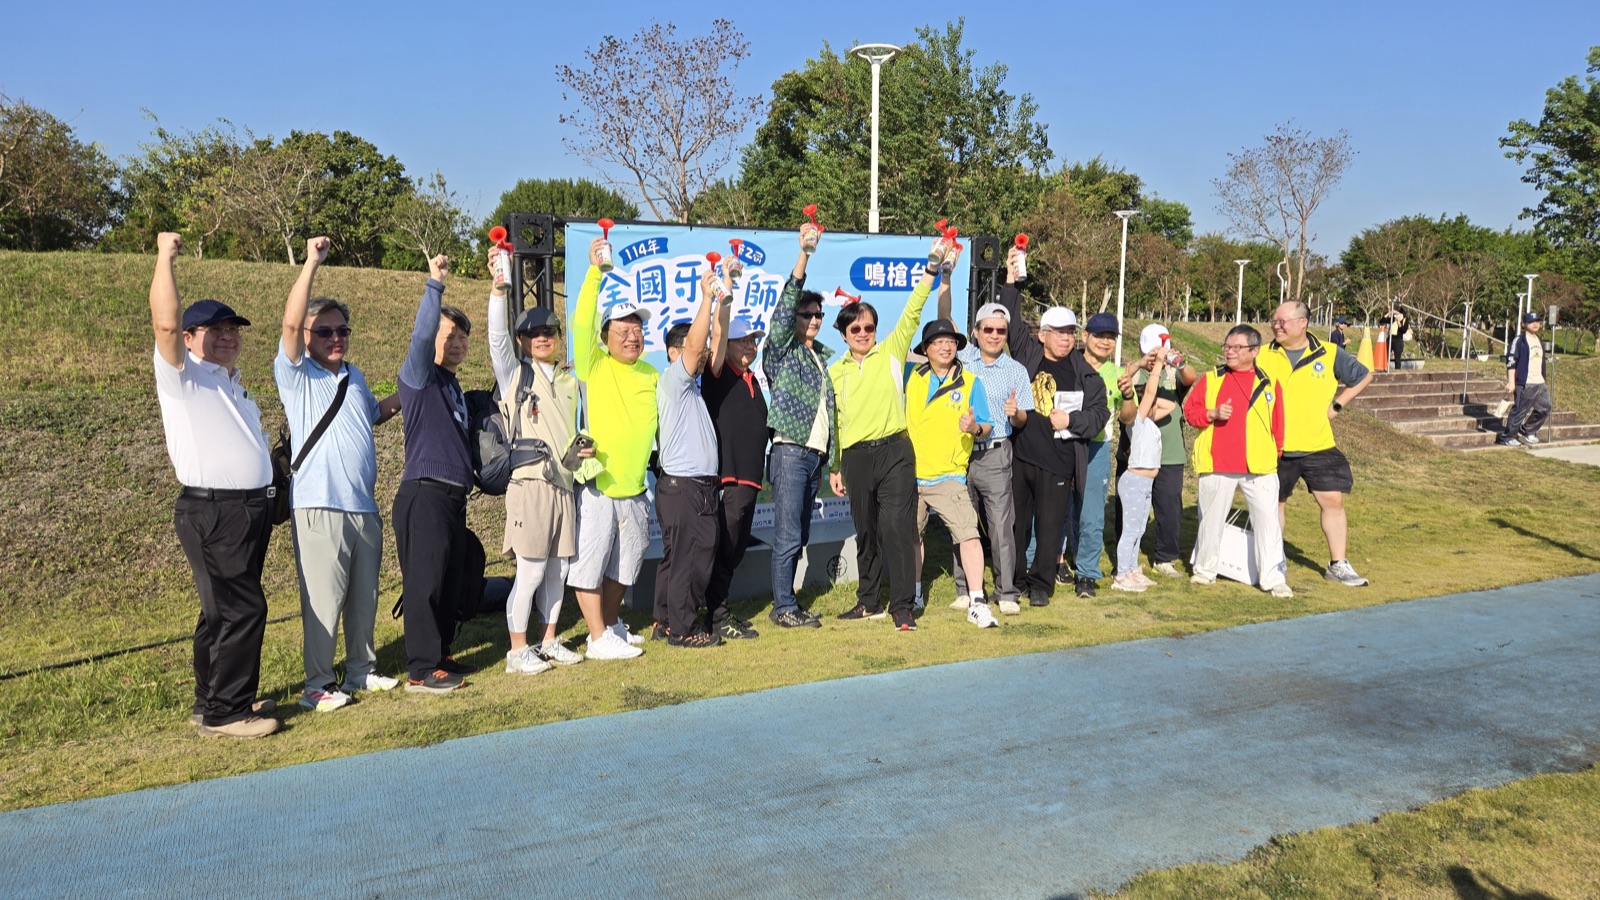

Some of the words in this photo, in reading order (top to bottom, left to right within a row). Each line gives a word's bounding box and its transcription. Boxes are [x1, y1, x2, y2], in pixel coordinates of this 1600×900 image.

[625, 239, 660, 261] 114年
[864, 261, 927, 288] 鳴槍台
